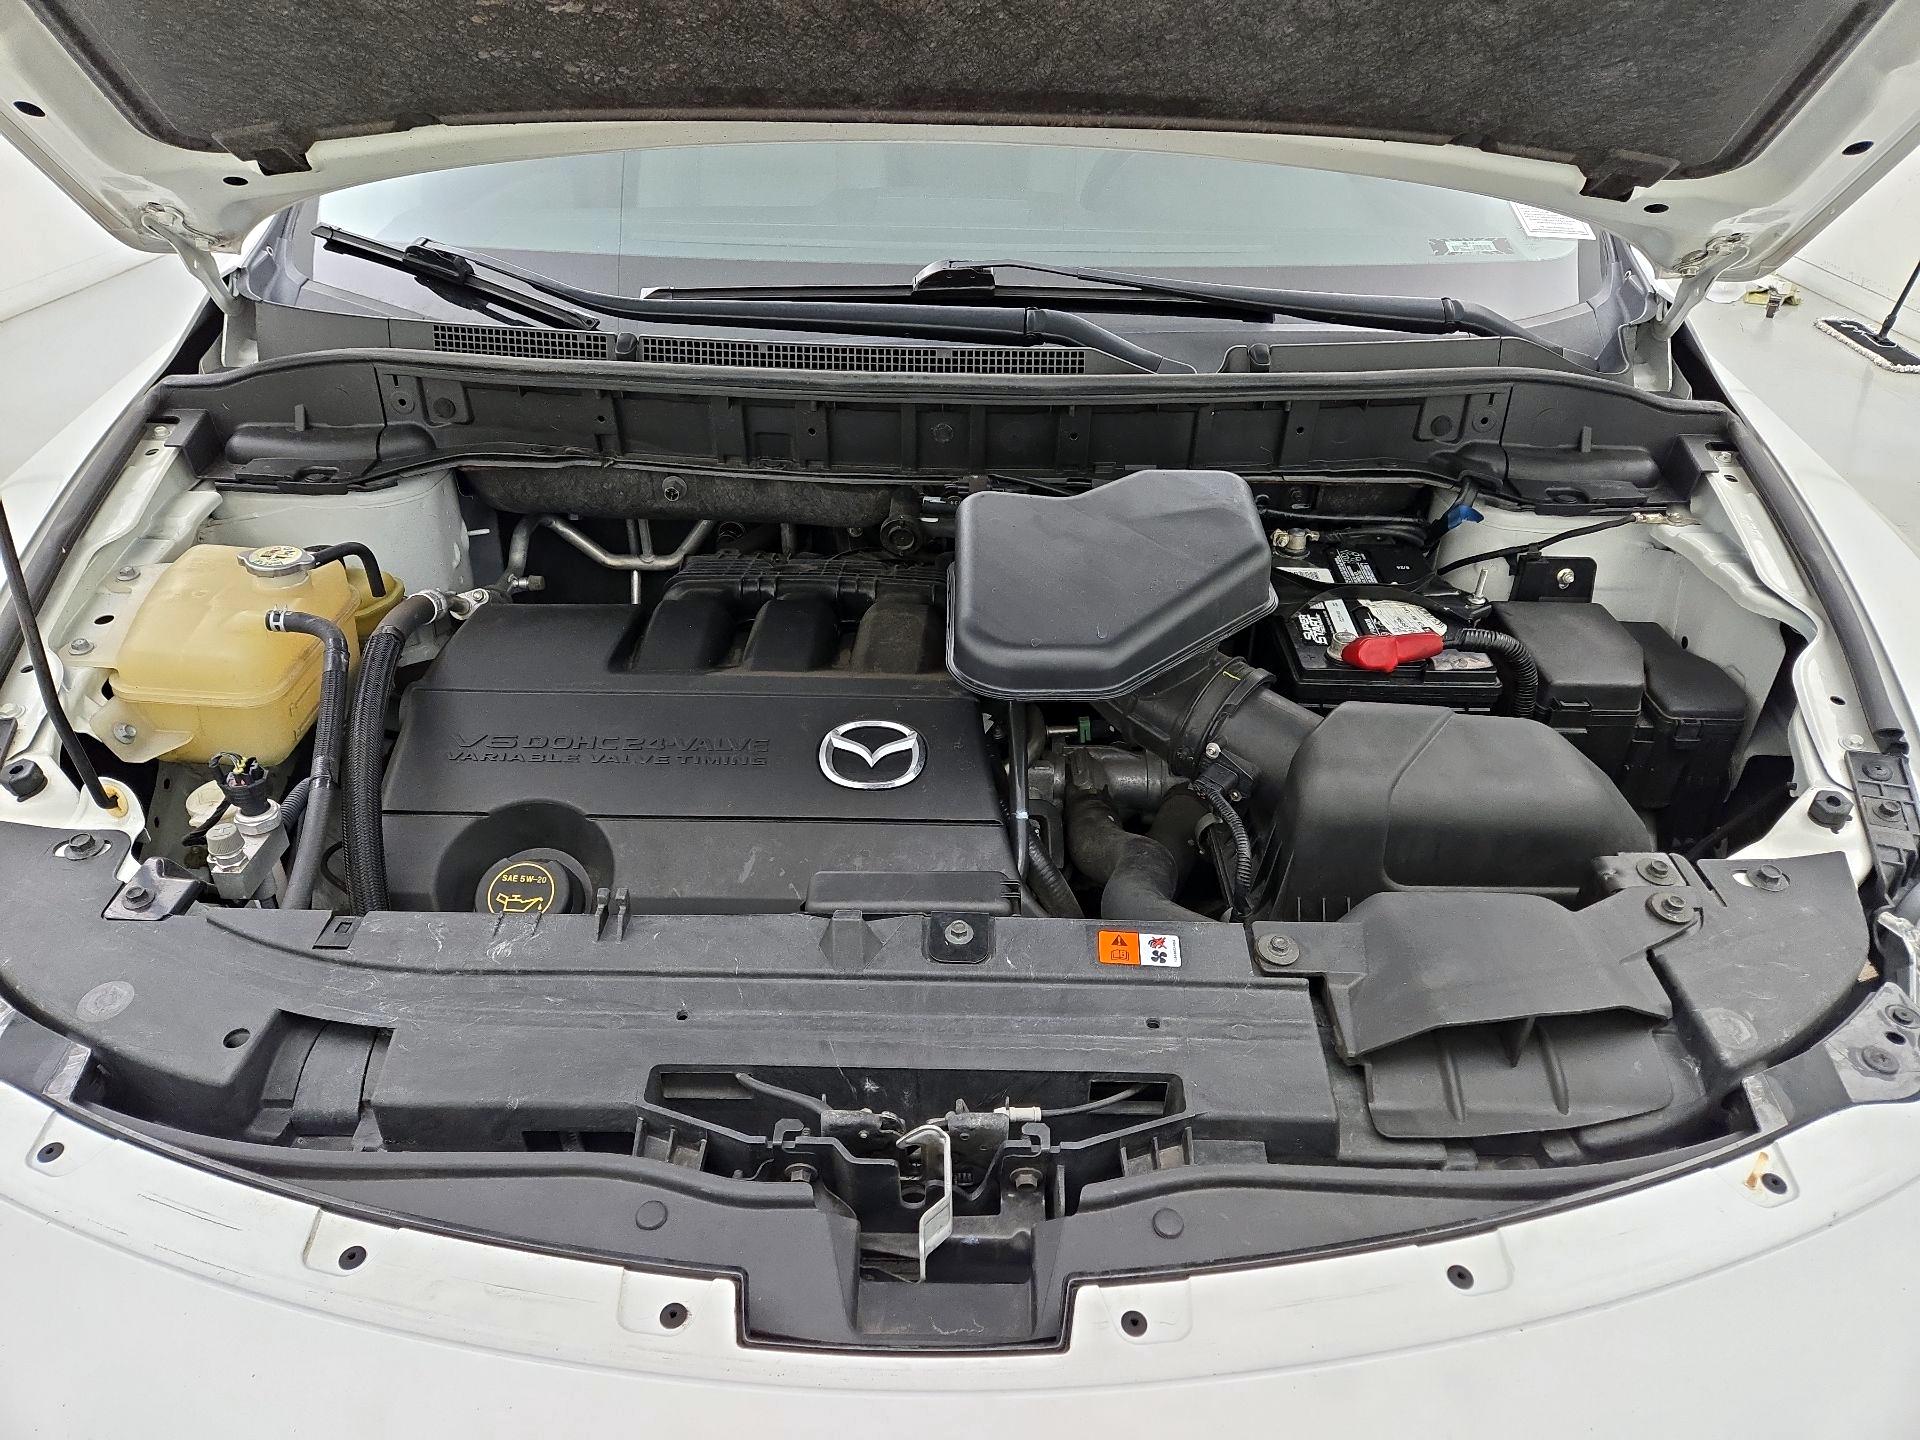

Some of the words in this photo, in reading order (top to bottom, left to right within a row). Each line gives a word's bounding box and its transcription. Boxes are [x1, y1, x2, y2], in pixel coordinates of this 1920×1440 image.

[1298, 613, 1313, 641] SUPER
[1308, 613, 1328, 645] START
[450, 733, 520, 749] V6
[521, 735, 621, 751] DOHC
[621, 736, 771, 753] 24-VALVE
[447, 751, 582, 763] VARIABLE
[590, 753, 671, 765] VALVE
[675, 754, 769, 766] TIMING
[501, 874, 519, 882] SAE
[519, 875, 547, 884] 5W-20
